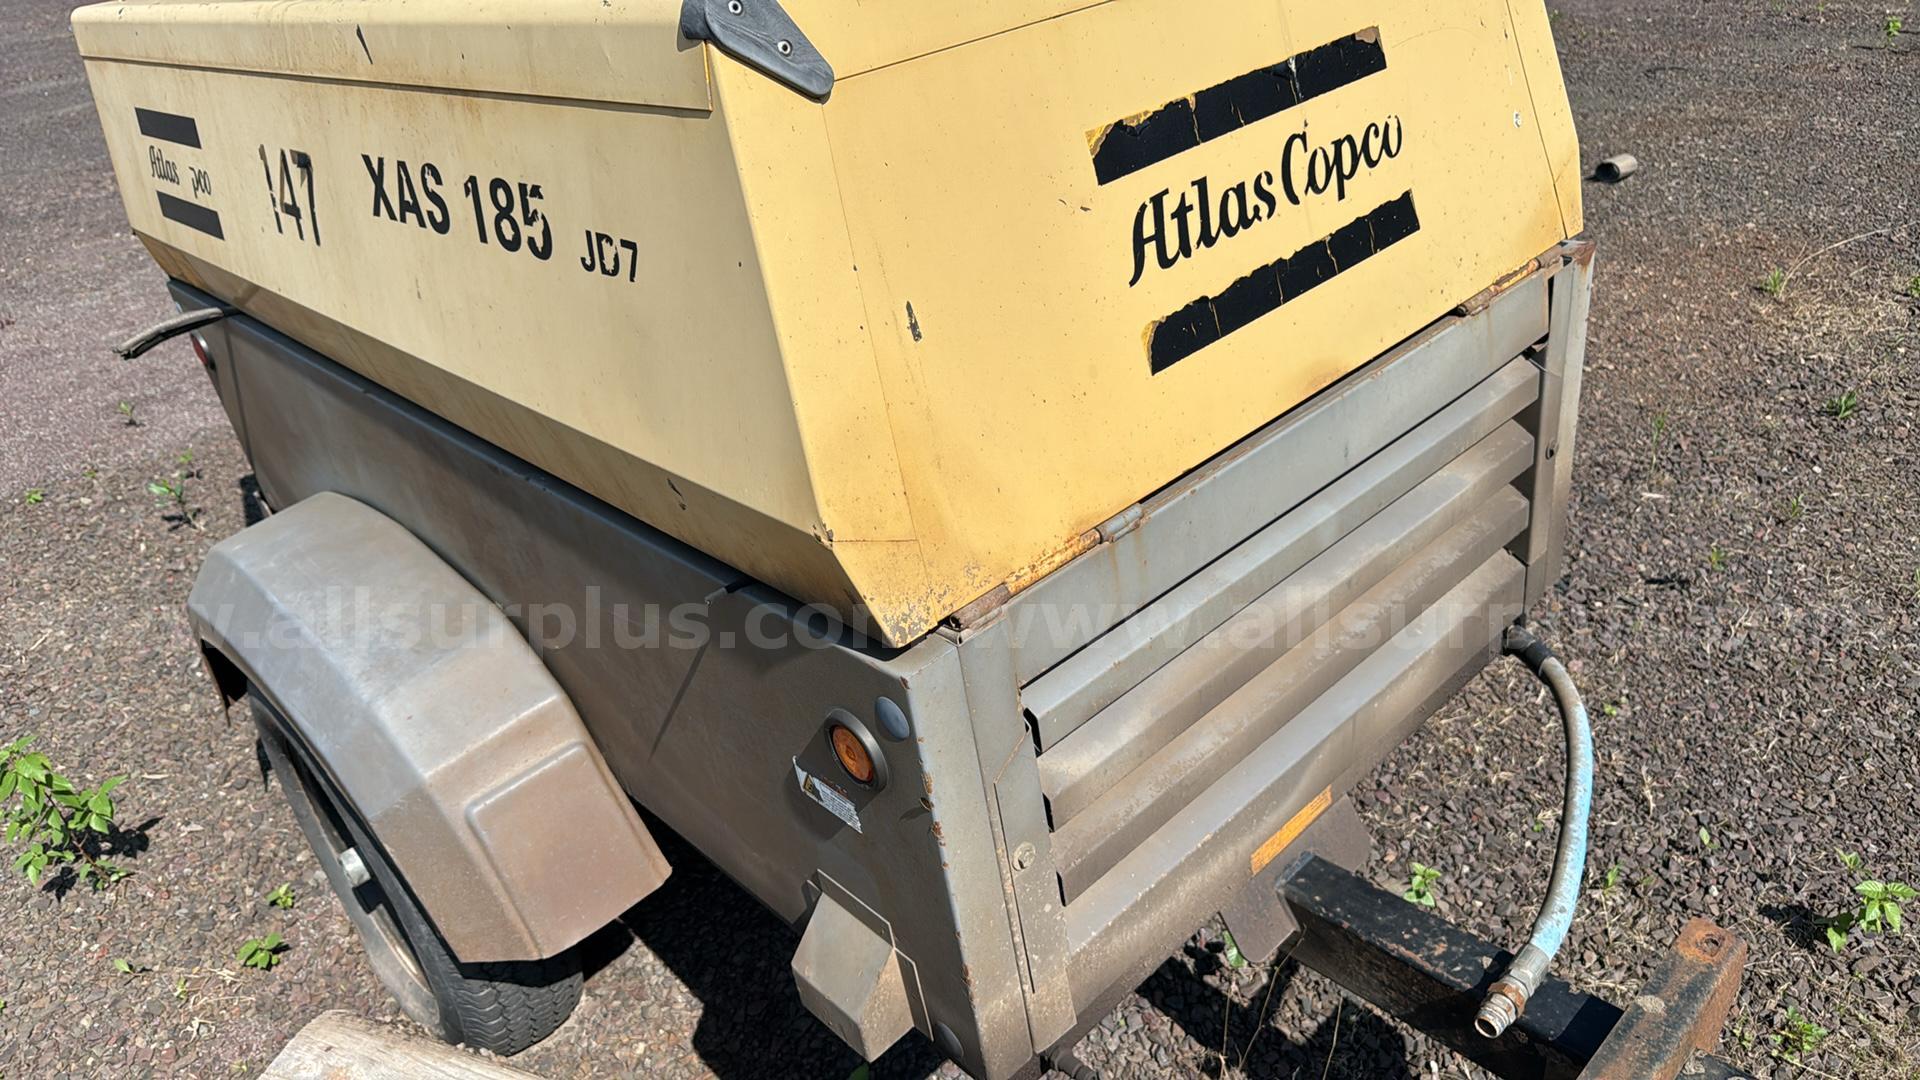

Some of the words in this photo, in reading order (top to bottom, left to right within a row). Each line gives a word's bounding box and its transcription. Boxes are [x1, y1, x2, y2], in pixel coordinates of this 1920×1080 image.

[149, 145, 180, 185] Atlas
[188, 166, 211, 199] pco
[258, 143, 321, 247] 147
[361, 153, 450, 236] XAS
[463, 174, 553, 262] 185
[580, 229, 639, 283] JD7
[1129, 170, 1277, 288] Atlas
[1281, 114, 1403, 206] Copco
